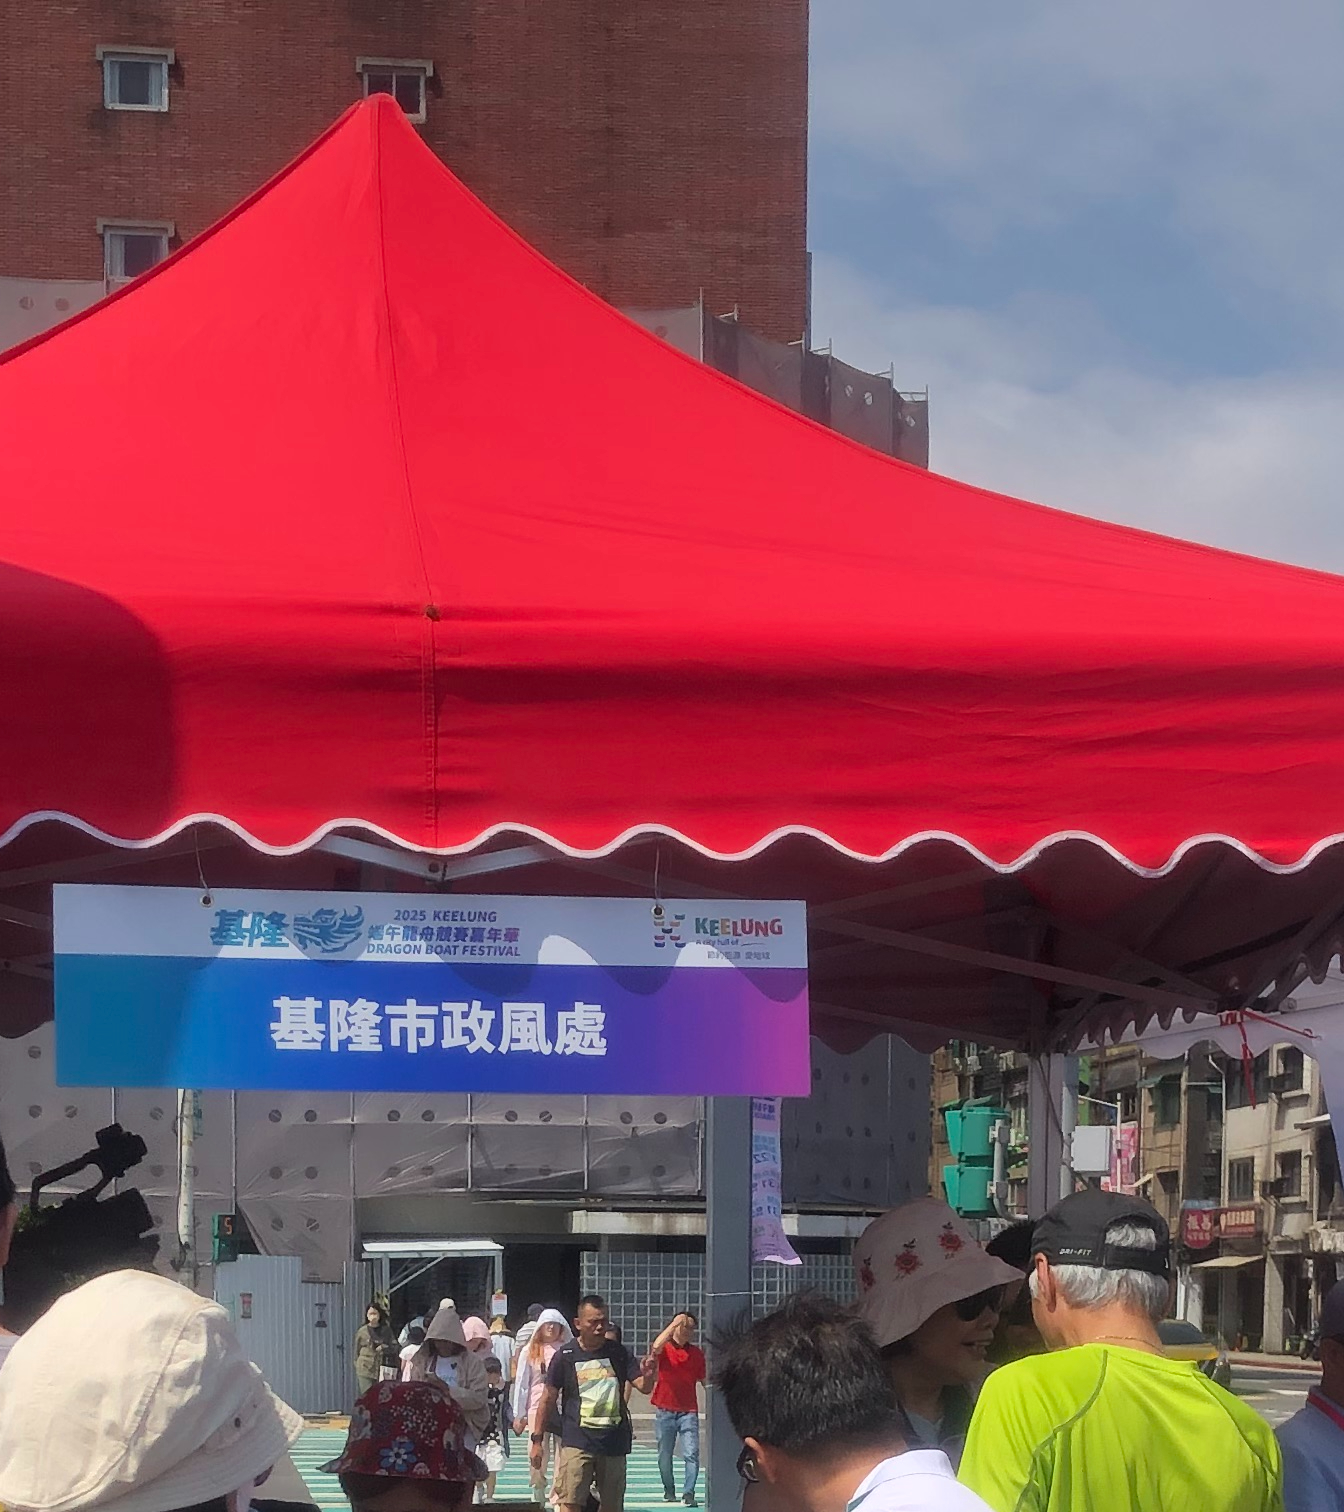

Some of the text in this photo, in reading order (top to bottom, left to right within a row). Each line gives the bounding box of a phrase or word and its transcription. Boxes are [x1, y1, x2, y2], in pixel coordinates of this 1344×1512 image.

[394, 909, 497, 923] 2025 KEELUNG
[210, 908, 290, 948] 基隆
[695, 917, 783, 937] KEELUNG
[367, 943, 521, 957] DRAGON BOAT FESTIVAL
[271, 995, 609, 1058] 基隆市政風處
